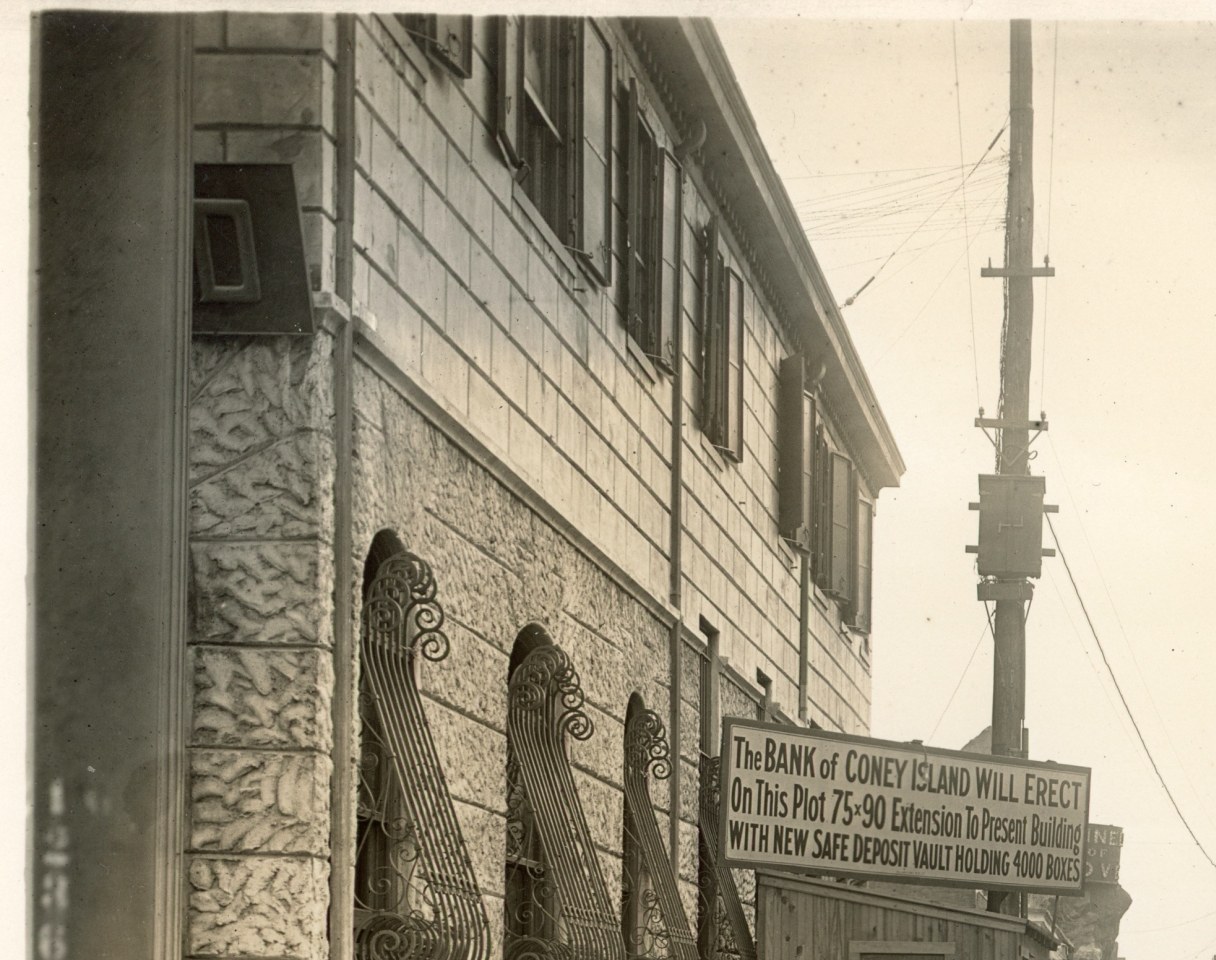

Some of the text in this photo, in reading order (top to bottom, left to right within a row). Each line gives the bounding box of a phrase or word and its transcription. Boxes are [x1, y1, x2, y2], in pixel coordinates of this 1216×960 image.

[733, 736, 1082, 810] The BANK of CONEY ISLAND WILL ERECT
[729, 820, 1080, 883] WITH NEW SAFE DEPOSIT VAULT HOLDING 4000 BOXES
[731, 777, 752, 814] On
[756, 779, 788, 818] This
[793, 784, 824, 822] Plot
[891, 797, 962, 839] Extension
[966, 805, 979, 841] To
[982, 808, 1027, 846] Present
[1031, 814, 1081, 856] Building
